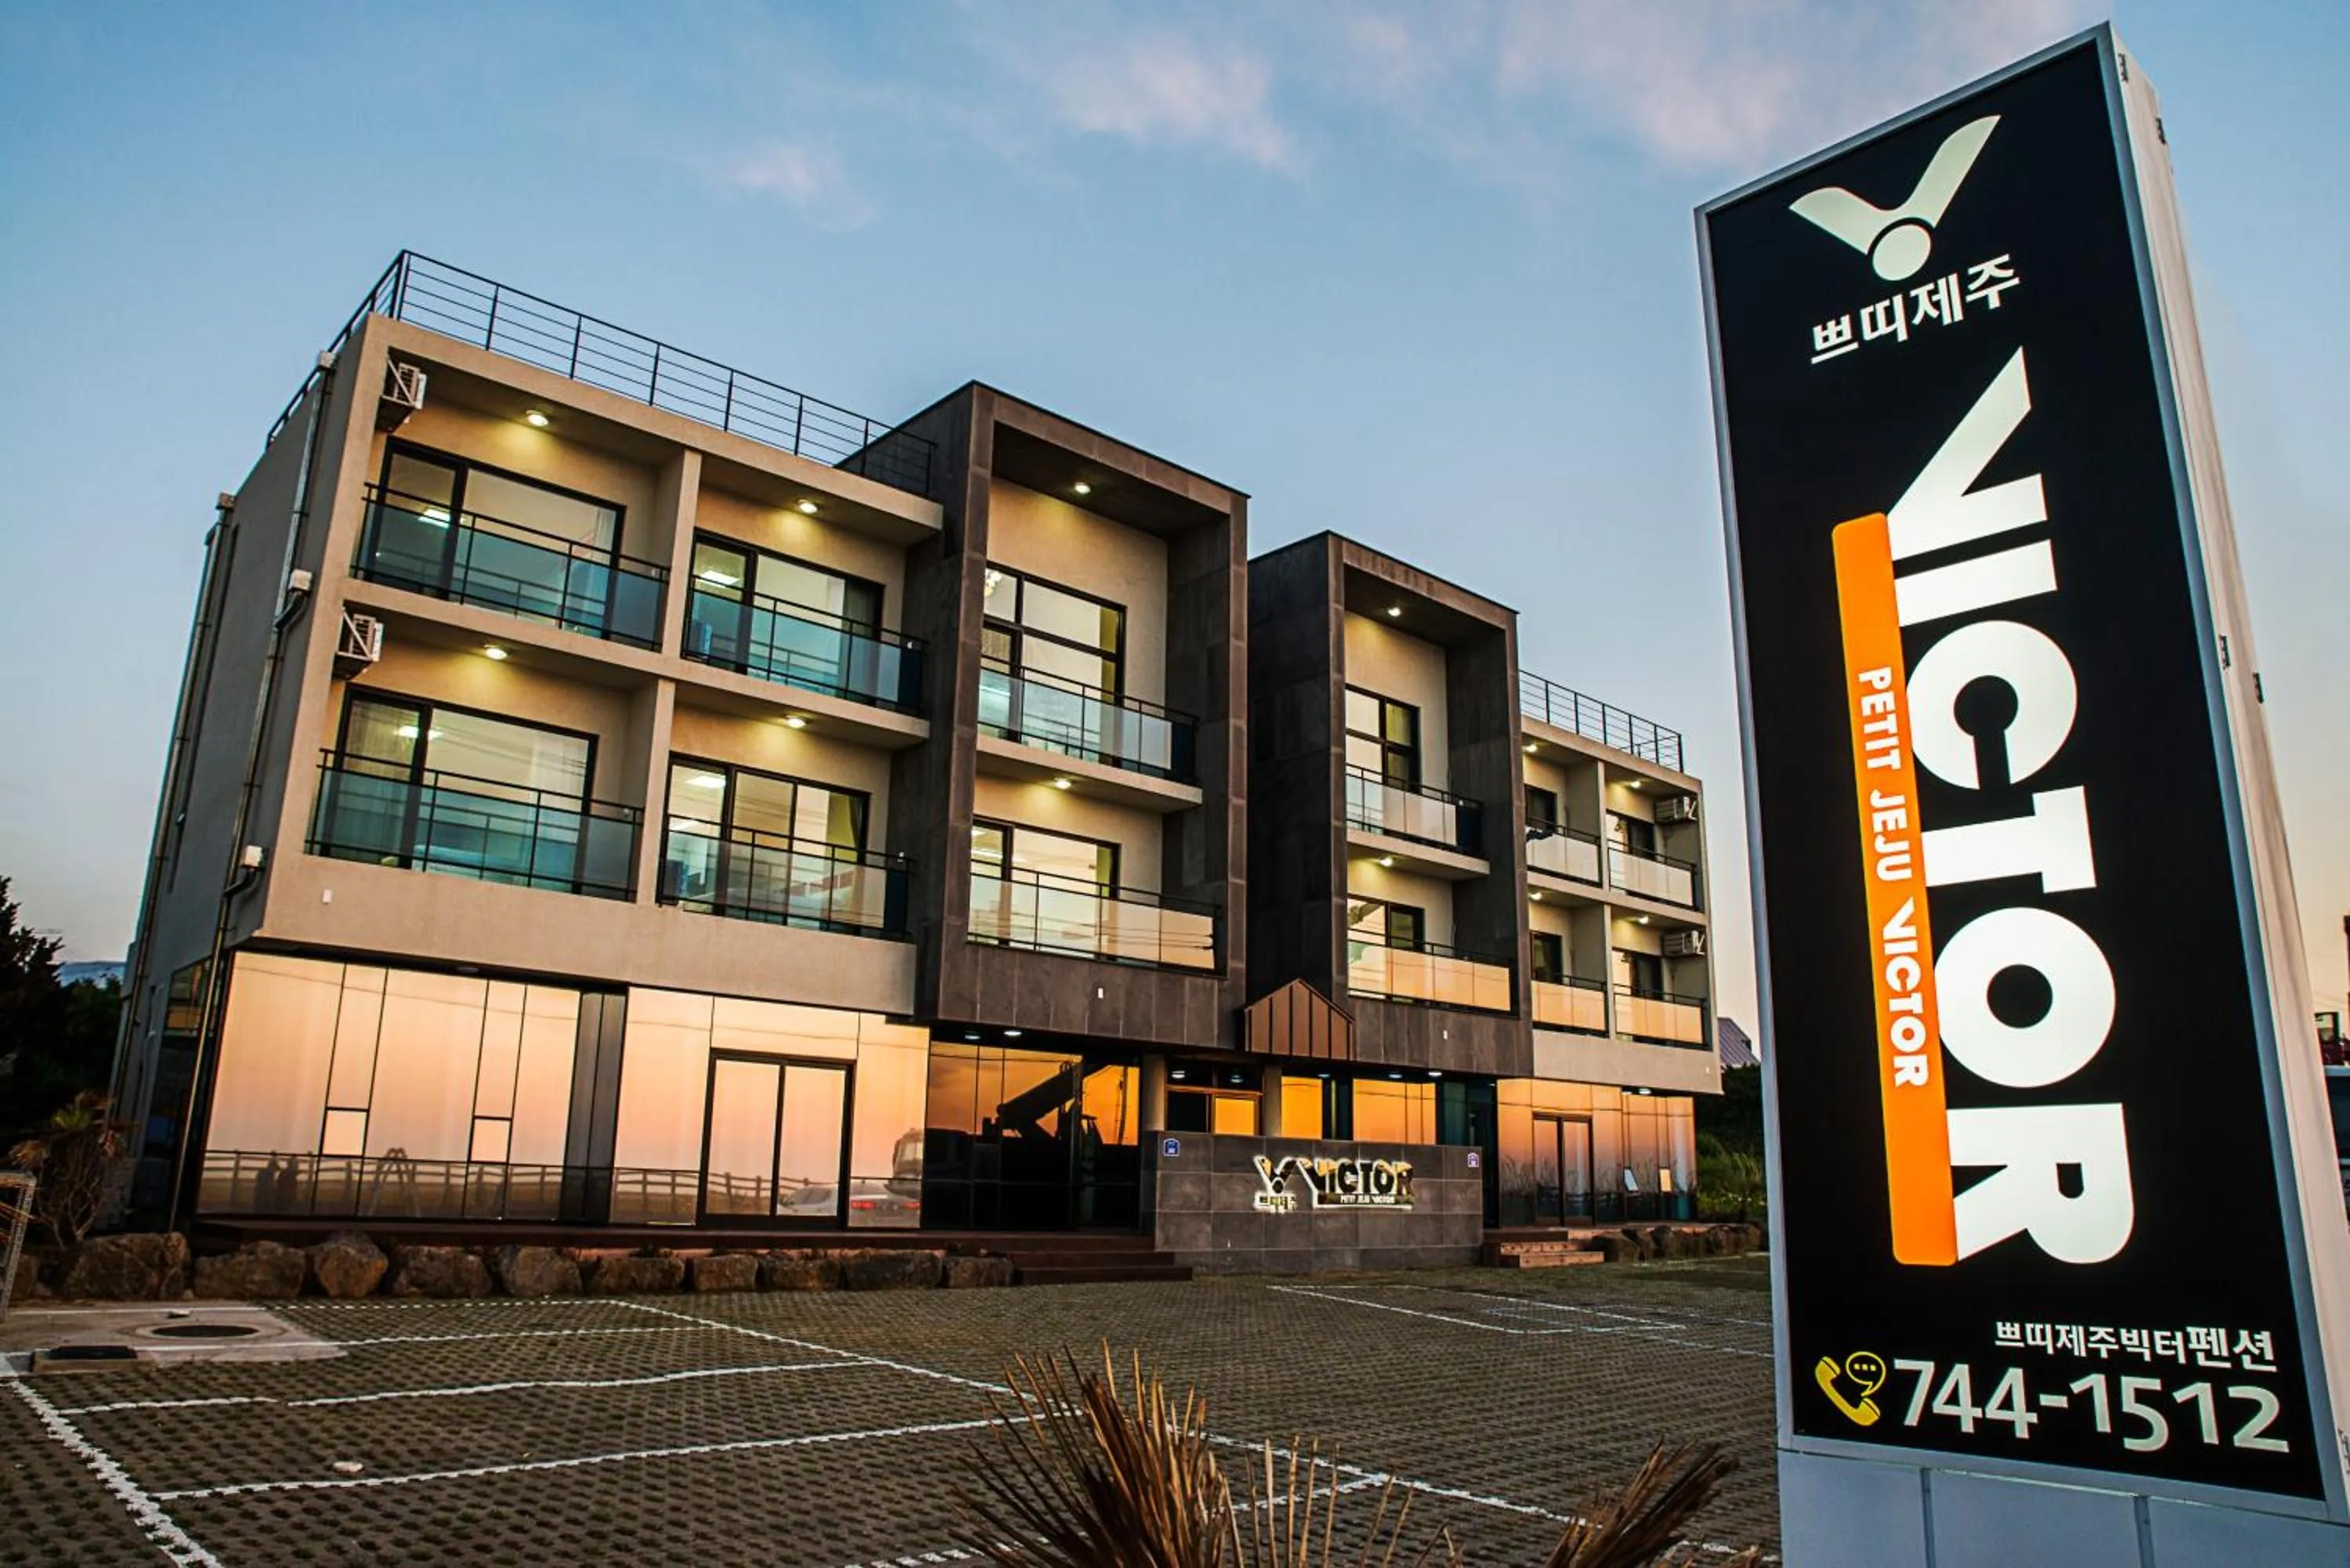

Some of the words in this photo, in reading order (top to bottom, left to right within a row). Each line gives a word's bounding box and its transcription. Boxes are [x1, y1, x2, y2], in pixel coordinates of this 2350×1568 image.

[1811, 253, 2021, 365] 쁘띠제주
[1858, 667, 1901, 770] PETIT
[1870, 789, 1912, 881] JEJU
[1886, 345, 2134, 1265] VICTOR
[1882, 897, 1929, 1086] VICTOR
[1297, 1158, 1413, 1198] VICTOR
[1994, 1321, 2277, 1373] 쁘띠제주빅터펜션
[1894, 1359, 2290, 1454] 744-1512
